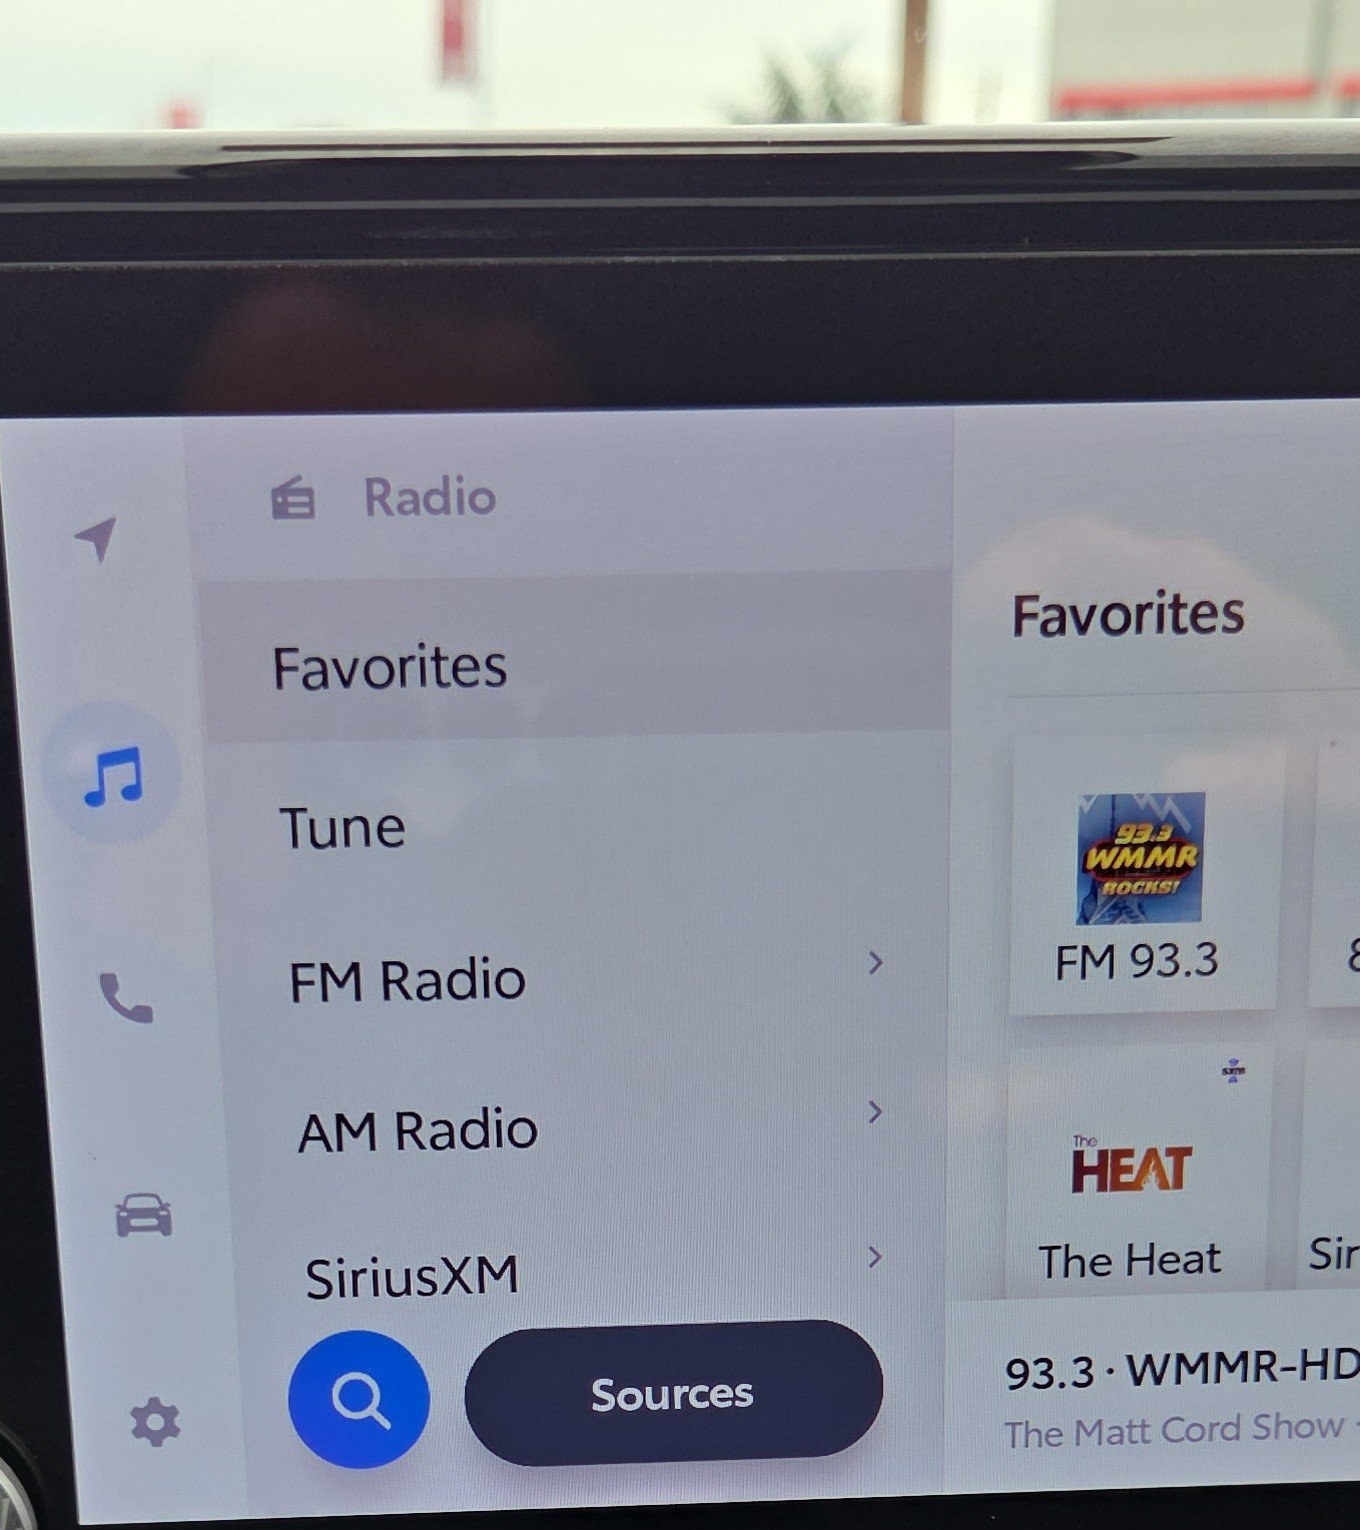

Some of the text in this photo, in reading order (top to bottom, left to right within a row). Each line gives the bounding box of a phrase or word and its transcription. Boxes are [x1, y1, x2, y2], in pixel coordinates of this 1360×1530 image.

[365, 474, 497, 517] Radio
[1013, 588, 1246, 638] Favorites
[274, 642, 508, 691] Favorites
[279, 807, 406, 850] Tune
[1114, 822, 1174, 845] 93.3
[1084, 844, 1199, 871] WMMR
[1100, 879, 1181, 896] ROCKS!
[290, 956, 527, 1003] FM Radio
[1056, 941, 1219, 981] FM 93.3
[297, 1106, 539, 1154] AM Radio
[1073, 1134, 1099, 1148] The
[1071, 1146, 1194, 1194] HEAT
[305, 1255, 519, 1301] SiriusXM
[1038, 1242, 1222, 1279] The Heat
[1004, 1354, 1096, 1391] 93.3
[591, 1377, 755, 1413] Sources
[1004, 1420, 1065, 1449] The
[1074, 1416, 1152, 1447] Matt
[1161, 1413, 1241, 1445] Cord
[1251, 1410, 1346, 1441] Show
